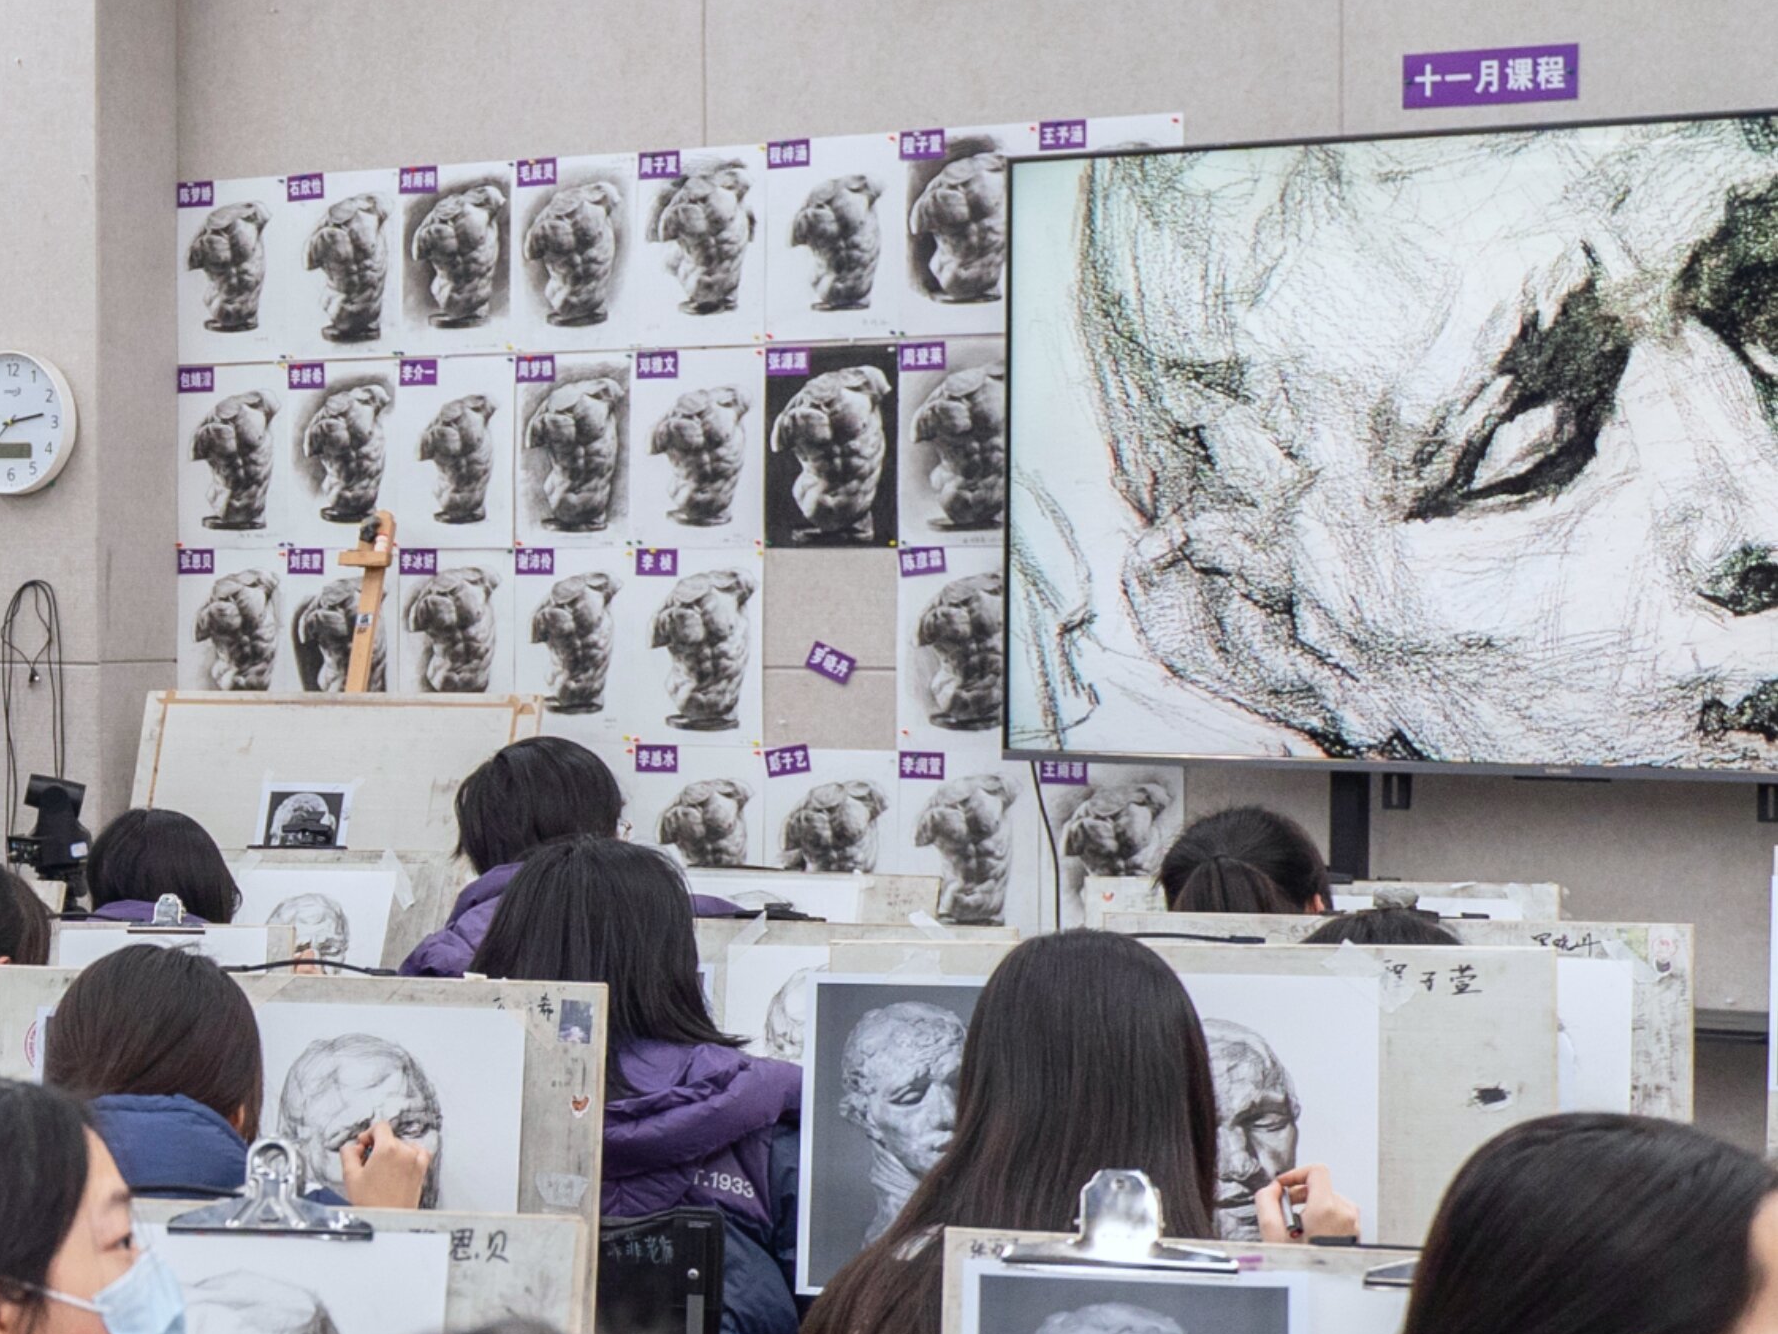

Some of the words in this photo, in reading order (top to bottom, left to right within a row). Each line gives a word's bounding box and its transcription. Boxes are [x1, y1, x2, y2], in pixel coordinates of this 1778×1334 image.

[1414, 56, 1566, 96] 十一月课程
[6, 363, 20, 377] 12
[31, 370, 37, 383] 1
[45, 389, 53, 403] 2
[51, 415, 59, 429] 3
[44, 441, 53, 454] 4
[6, 467, 15, 481] 6
[29, 461, 37, 475] 5
